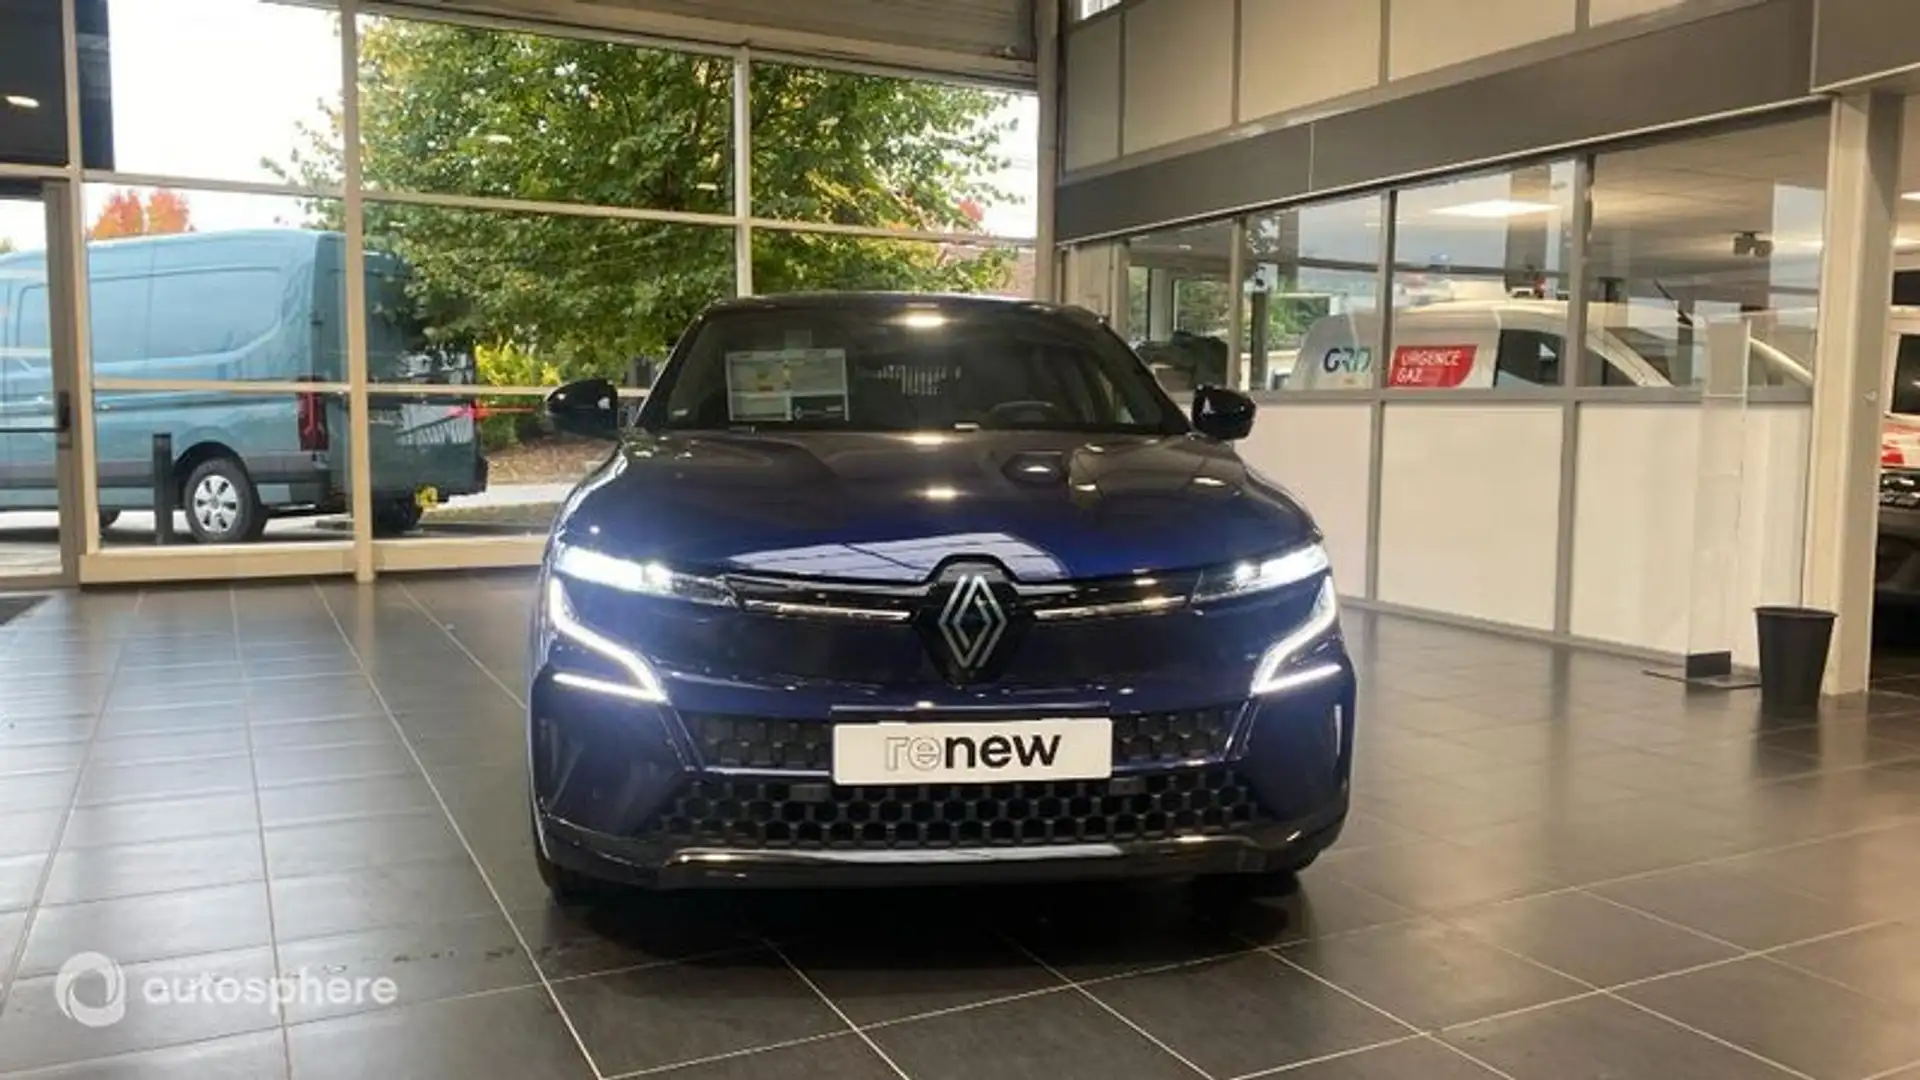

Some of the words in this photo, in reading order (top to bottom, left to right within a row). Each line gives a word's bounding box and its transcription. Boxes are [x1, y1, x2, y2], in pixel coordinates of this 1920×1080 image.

[1402, 350, 1460, 366] URGENCE
[1397, 368, 1423, 382] GAZ
[886, 735, 1061, 771] renew
